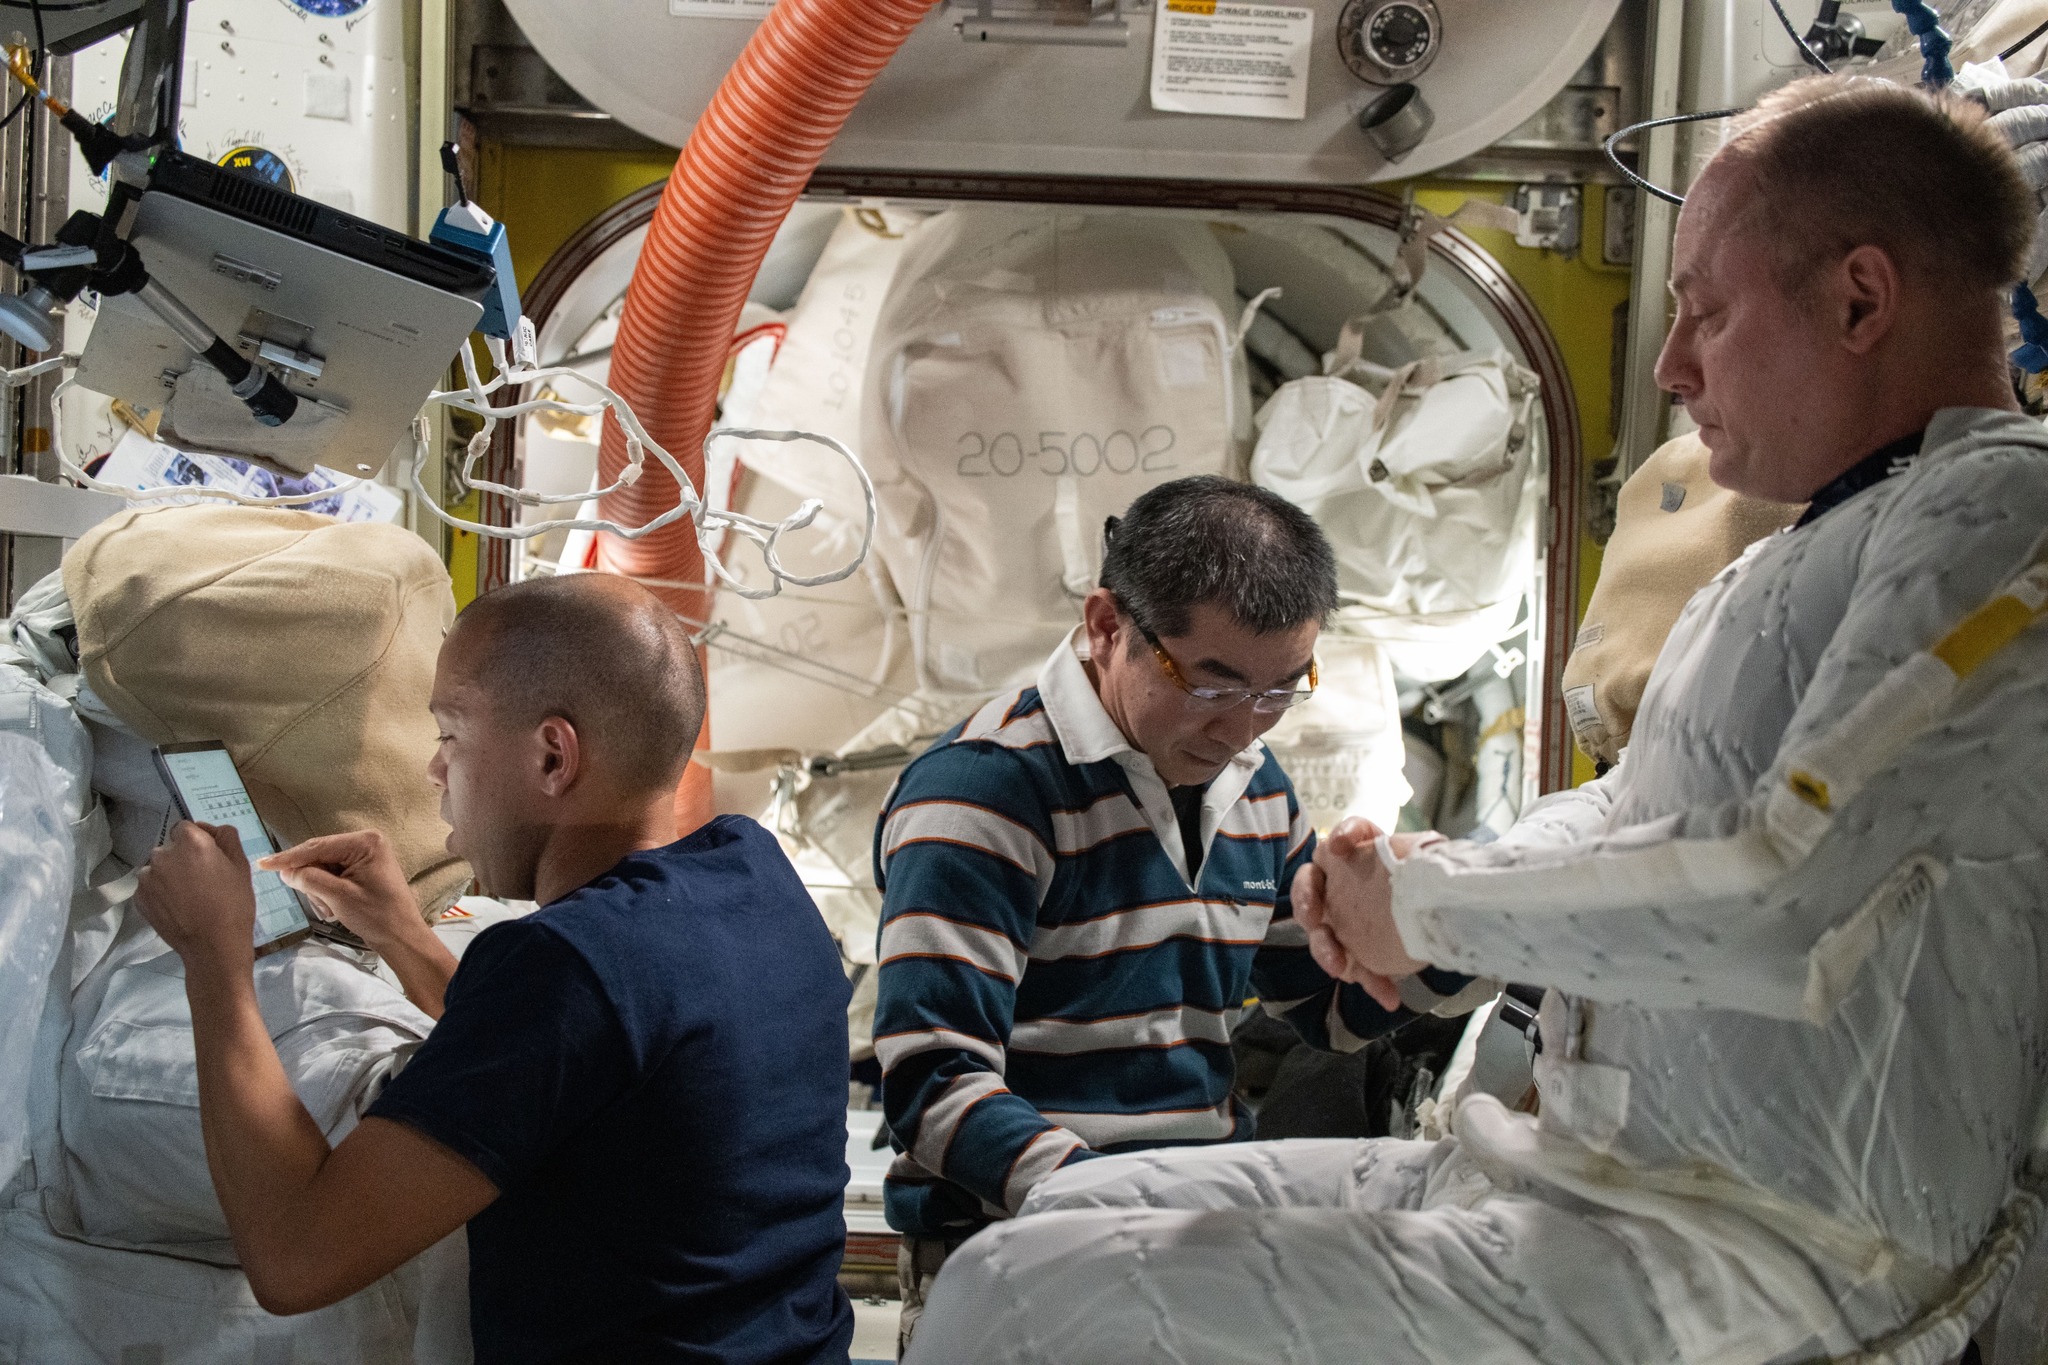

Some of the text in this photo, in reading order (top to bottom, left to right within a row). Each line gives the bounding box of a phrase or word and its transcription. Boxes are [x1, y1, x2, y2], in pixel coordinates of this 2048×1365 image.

[1253, 8, 1308, 20] GUIDELINES
[233, 157, 251, 168] XVI
[956, 424, 1179, 478] 20-5002
